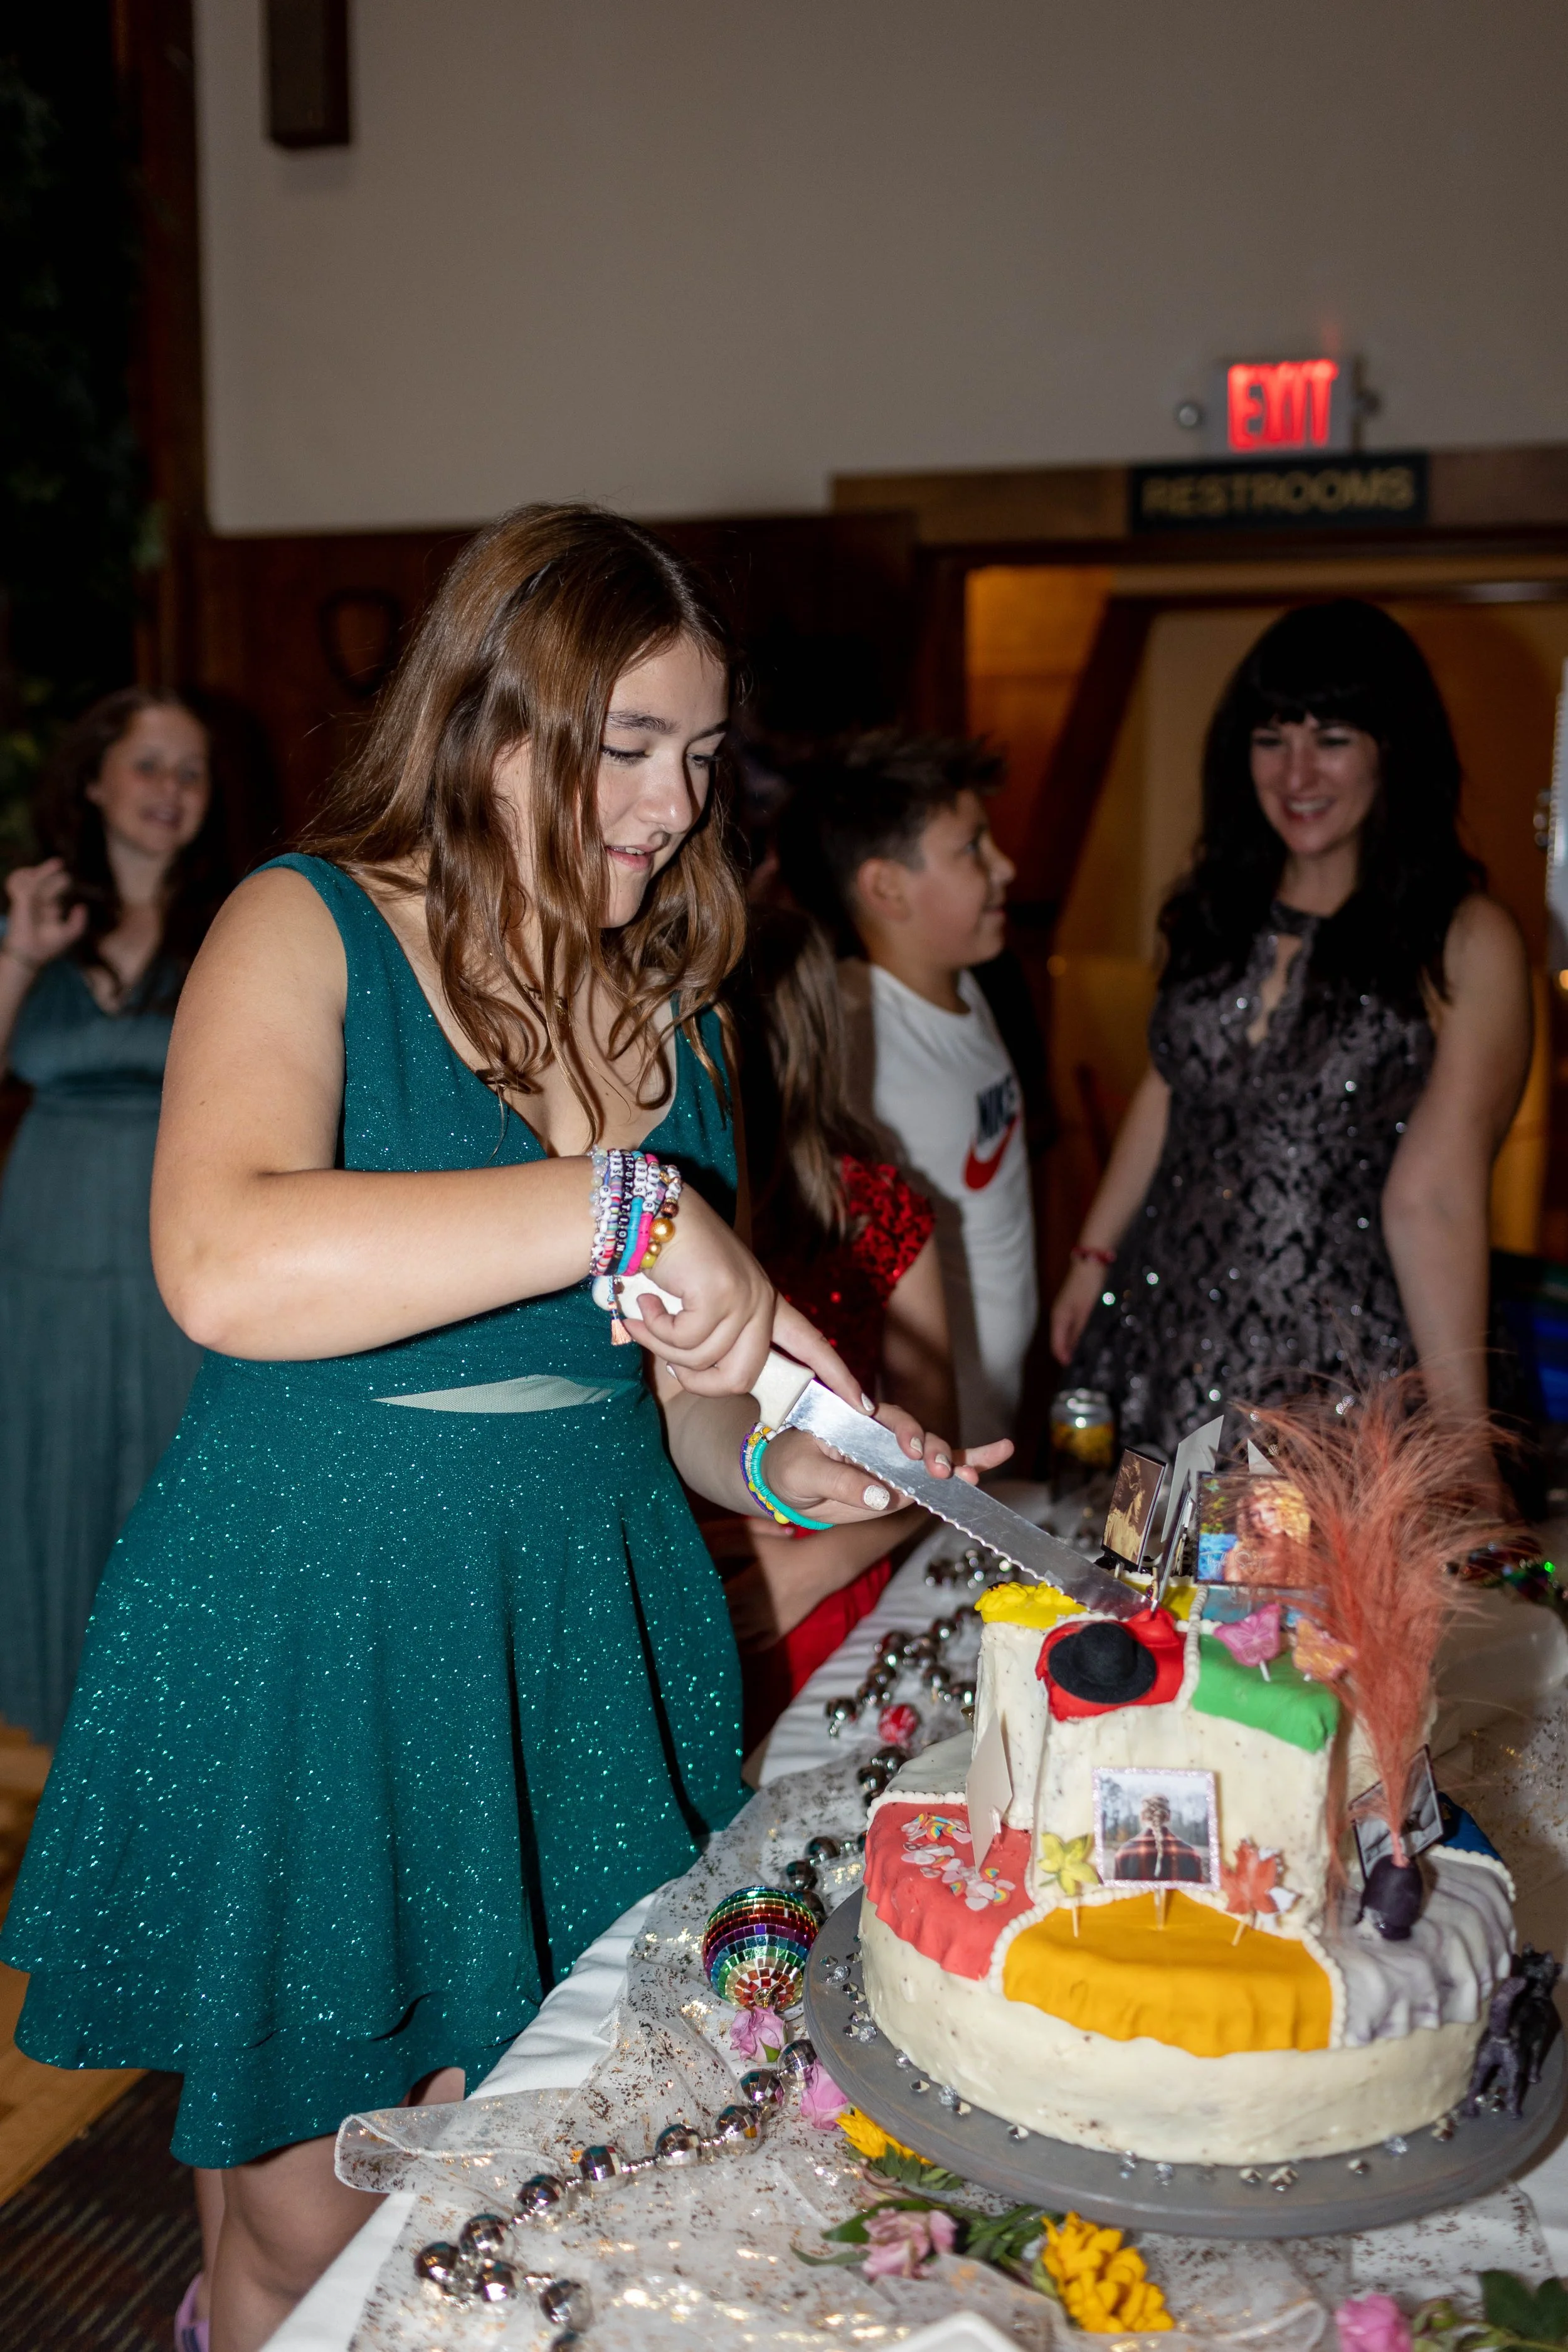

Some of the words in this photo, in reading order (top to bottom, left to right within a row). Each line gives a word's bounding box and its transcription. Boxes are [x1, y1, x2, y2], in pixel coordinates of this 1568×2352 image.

[1227, 359, 1338, 452] EXIT
[1142, 467, 1414, 516] RESTROOMS
[616, 1153, 634, 1252] EPUTATION
[635, 1162, 645, 1193] 1989
